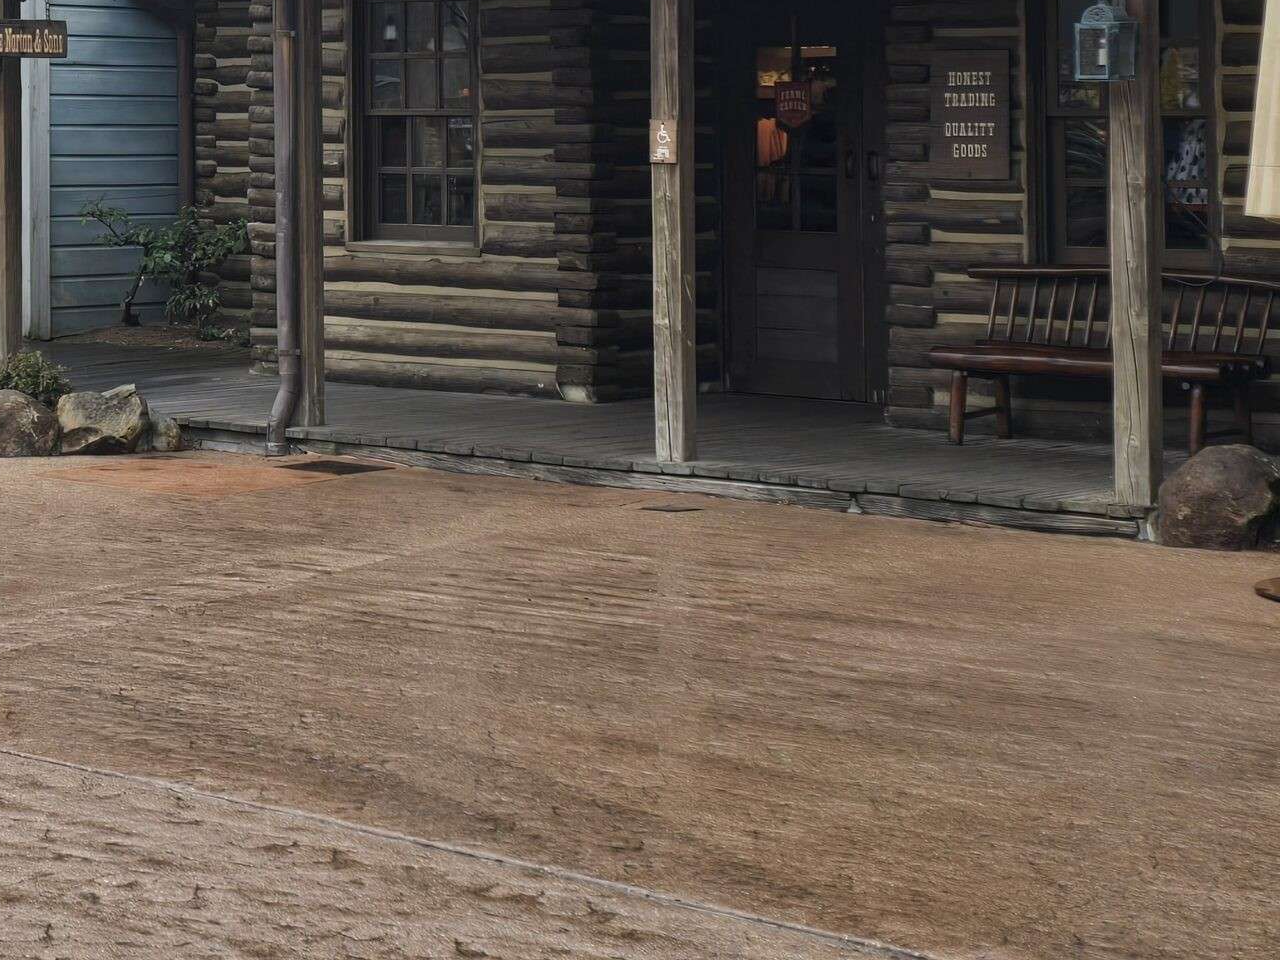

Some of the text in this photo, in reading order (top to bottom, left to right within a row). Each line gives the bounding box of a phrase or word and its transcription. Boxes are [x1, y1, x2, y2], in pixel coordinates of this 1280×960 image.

[4, 27, 34, 53] Norton
[34, 28, 42, 53] &
[43, 28, 64, 53] Sons
[947, 71, 992, 86] HONEST
[944, 93, 997, 107] TRADING
[945, 122, 995, 136] QUALITY
[953, 144, 988, 158] GOODS
